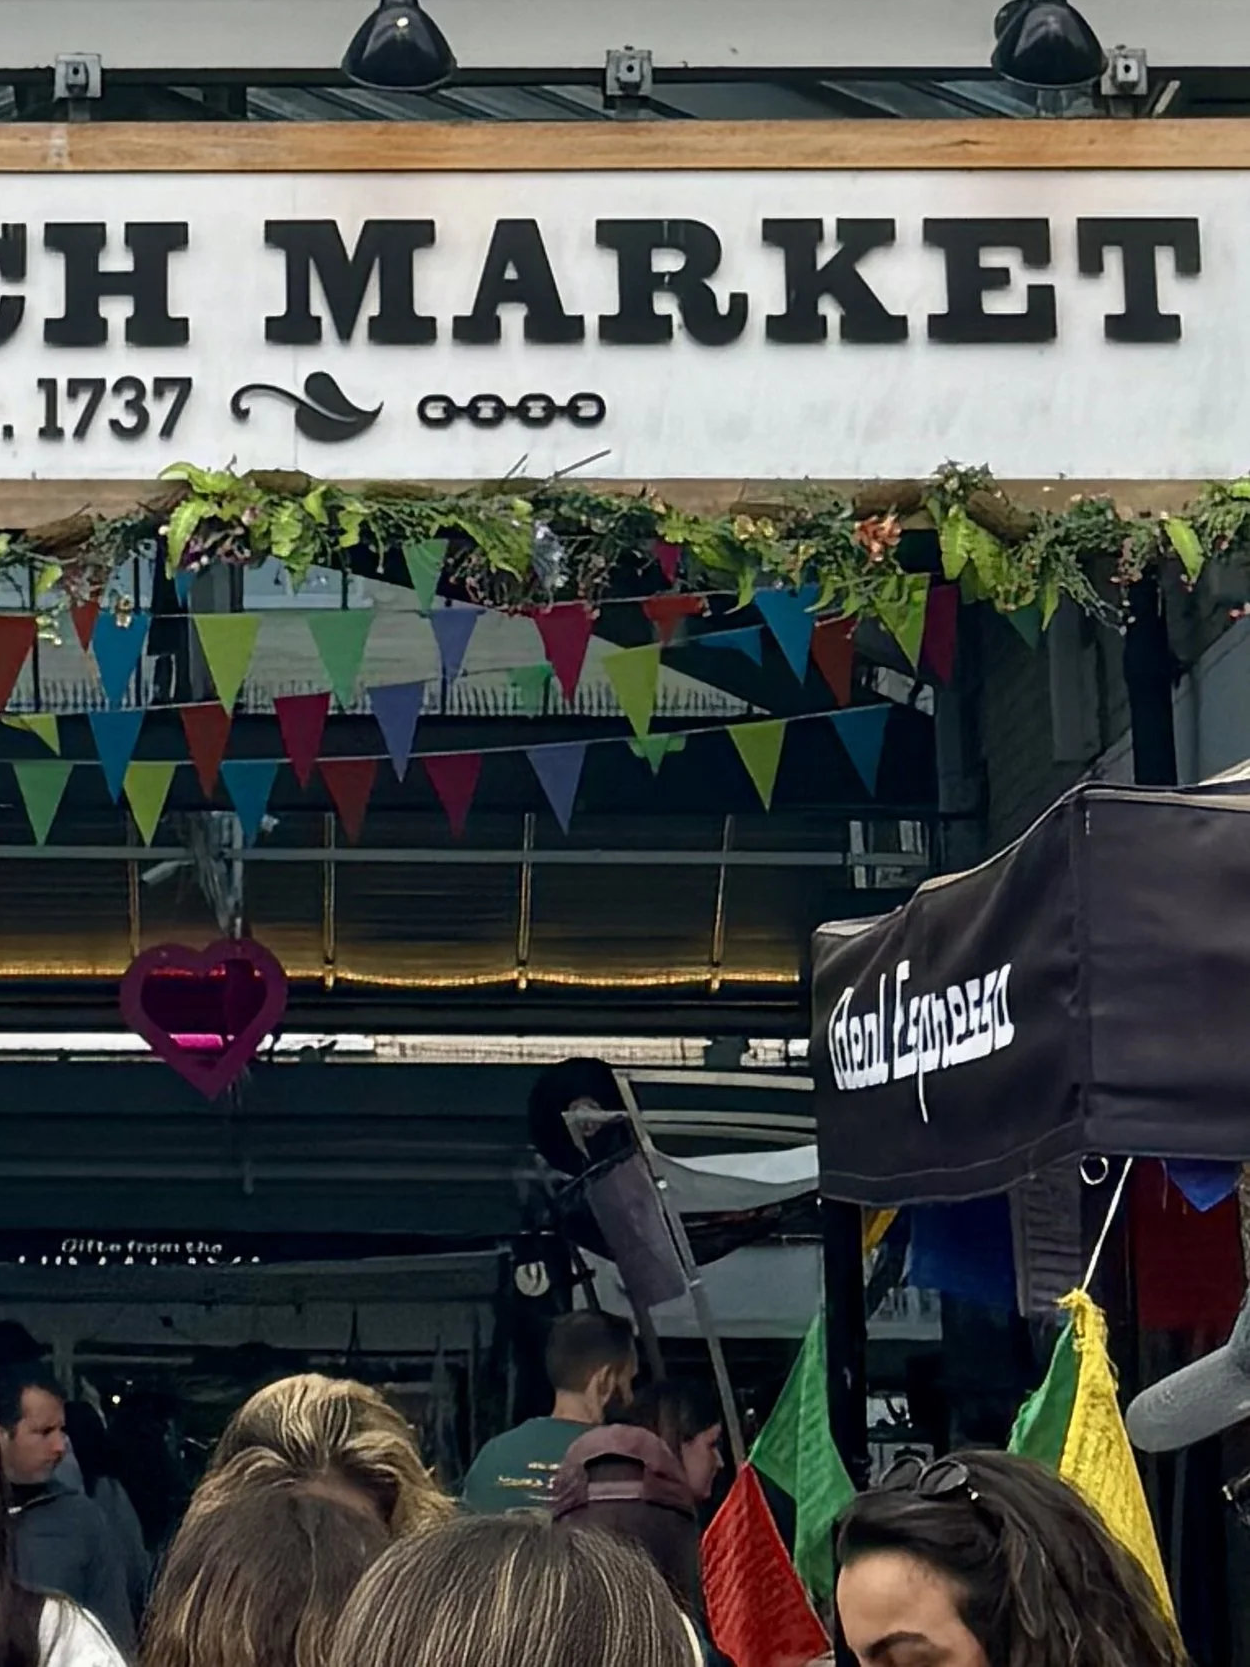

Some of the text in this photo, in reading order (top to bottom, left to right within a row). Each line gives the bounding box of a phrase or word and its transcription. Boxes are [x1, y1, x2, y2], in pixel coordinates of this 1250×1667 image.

[265, 218, 1200, 346] MARKET
[38, 376, 192, 440] 1737
[893, 960, 1015, 1123] Espresso
